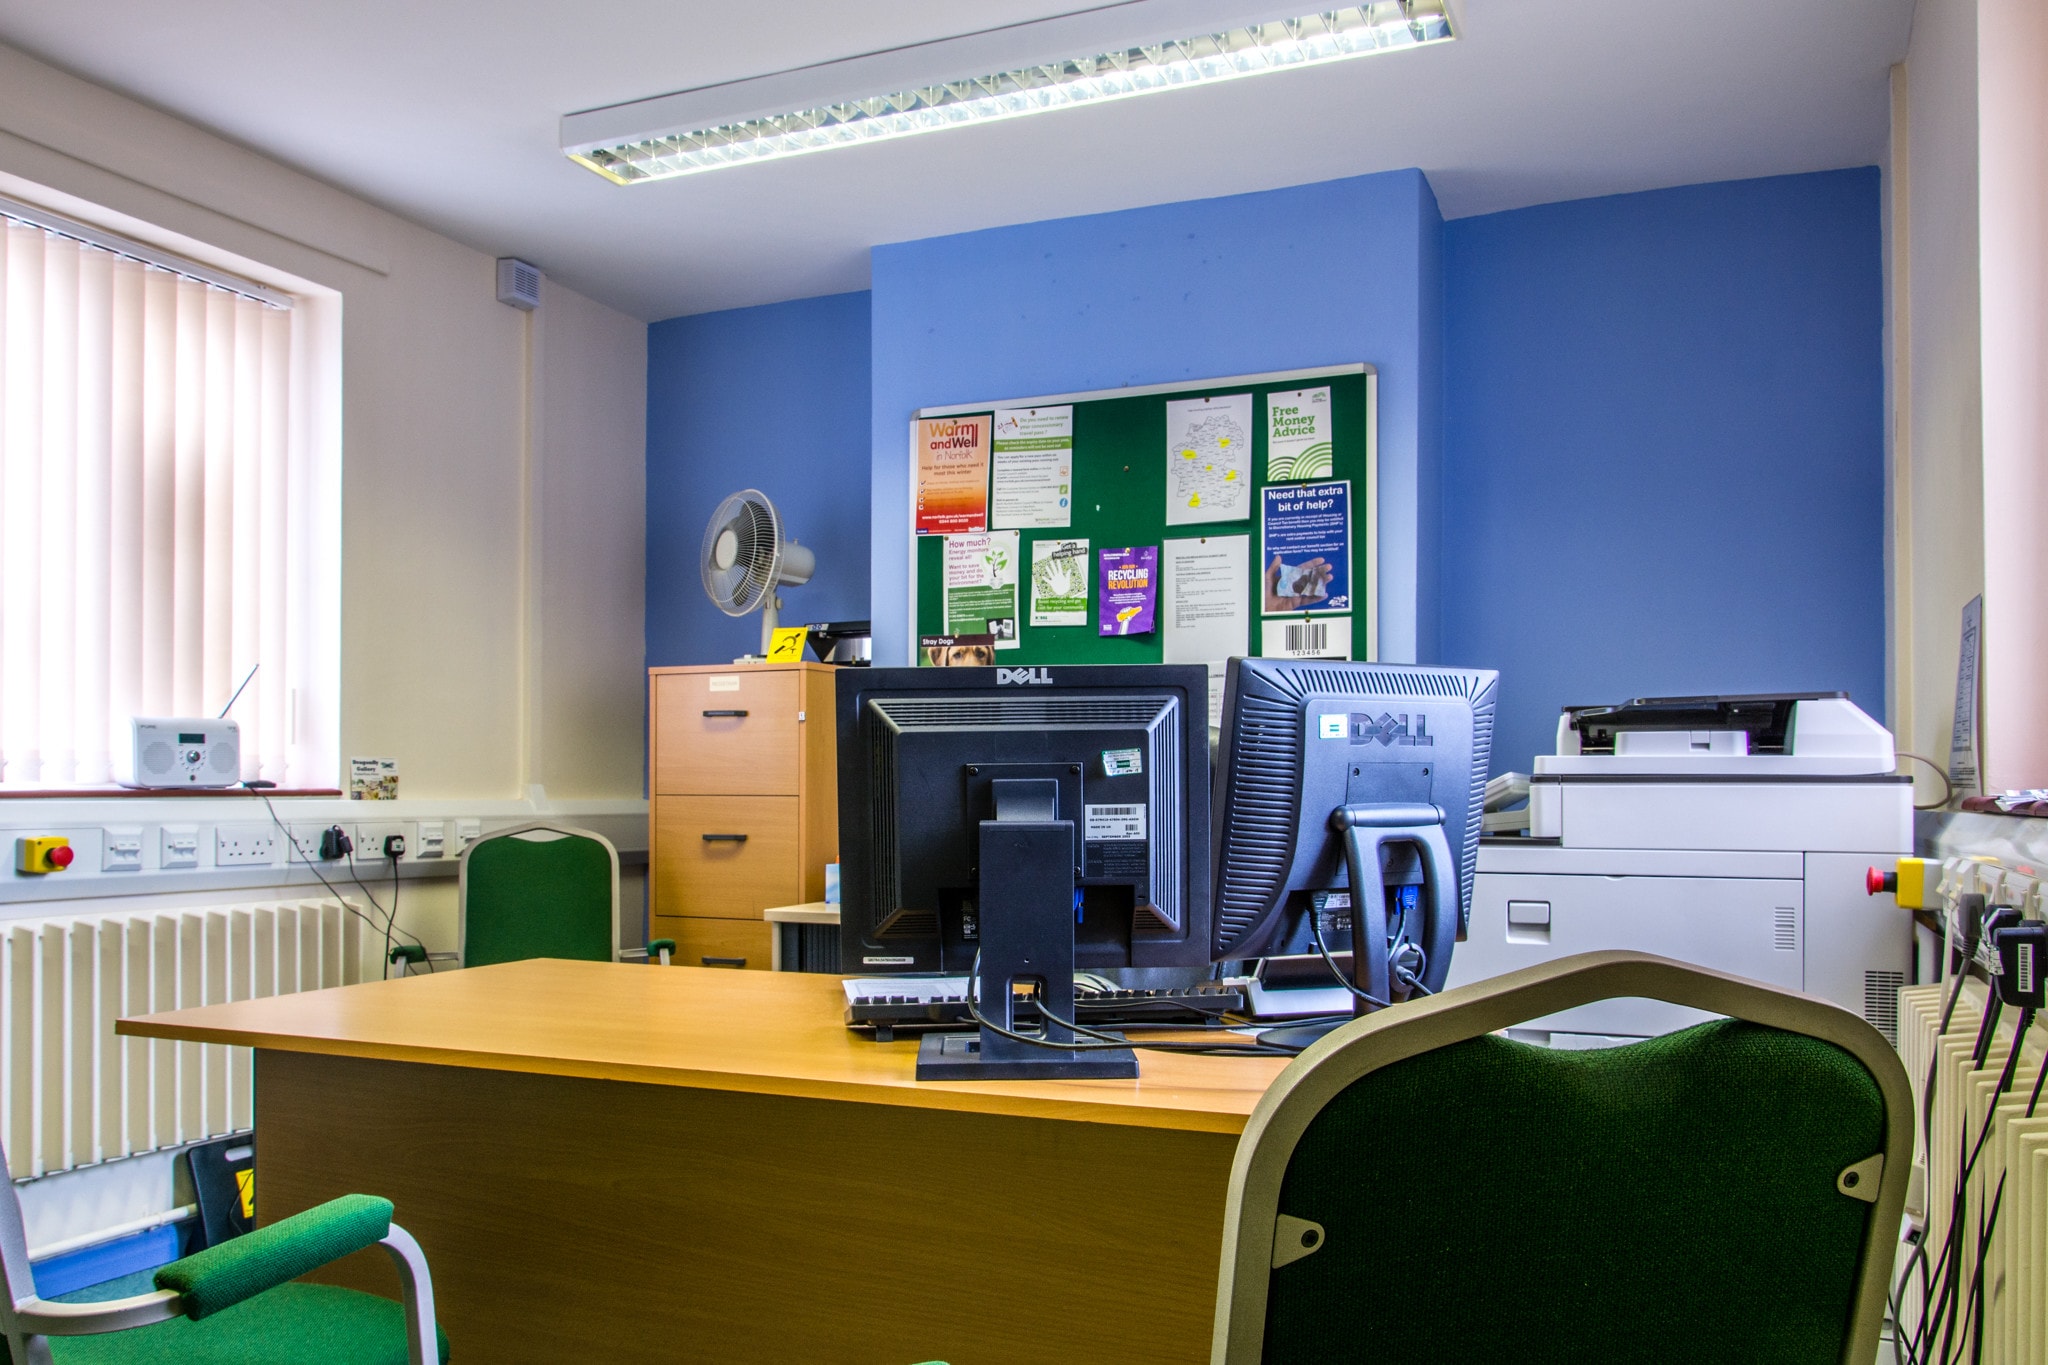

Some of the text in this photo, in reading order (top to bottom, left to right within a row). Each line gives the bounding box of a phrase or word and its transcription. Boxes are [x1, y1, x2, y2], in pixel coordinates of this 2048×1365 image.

[1272, 406, 1298, 416] Free
[1273, 415, 1315, 427] Money
[930, 422, 974, 437] Warm
[1272, 425, 1315, 438] Advice
[936, 449, 973, 460] in Norfolk
[1269, 486, 1343, 500] Need that extra
[1278, 499, 1333, 512] bit of help?
[967, 537, 991, 547] much?
[1108, 568, 1148, 580] RECYCLING
[1108, 579, 1148, 590] REVOLUTION
[997, 668, 1053, 685] DELL
[1350, 712, 1434, 747] DELL
